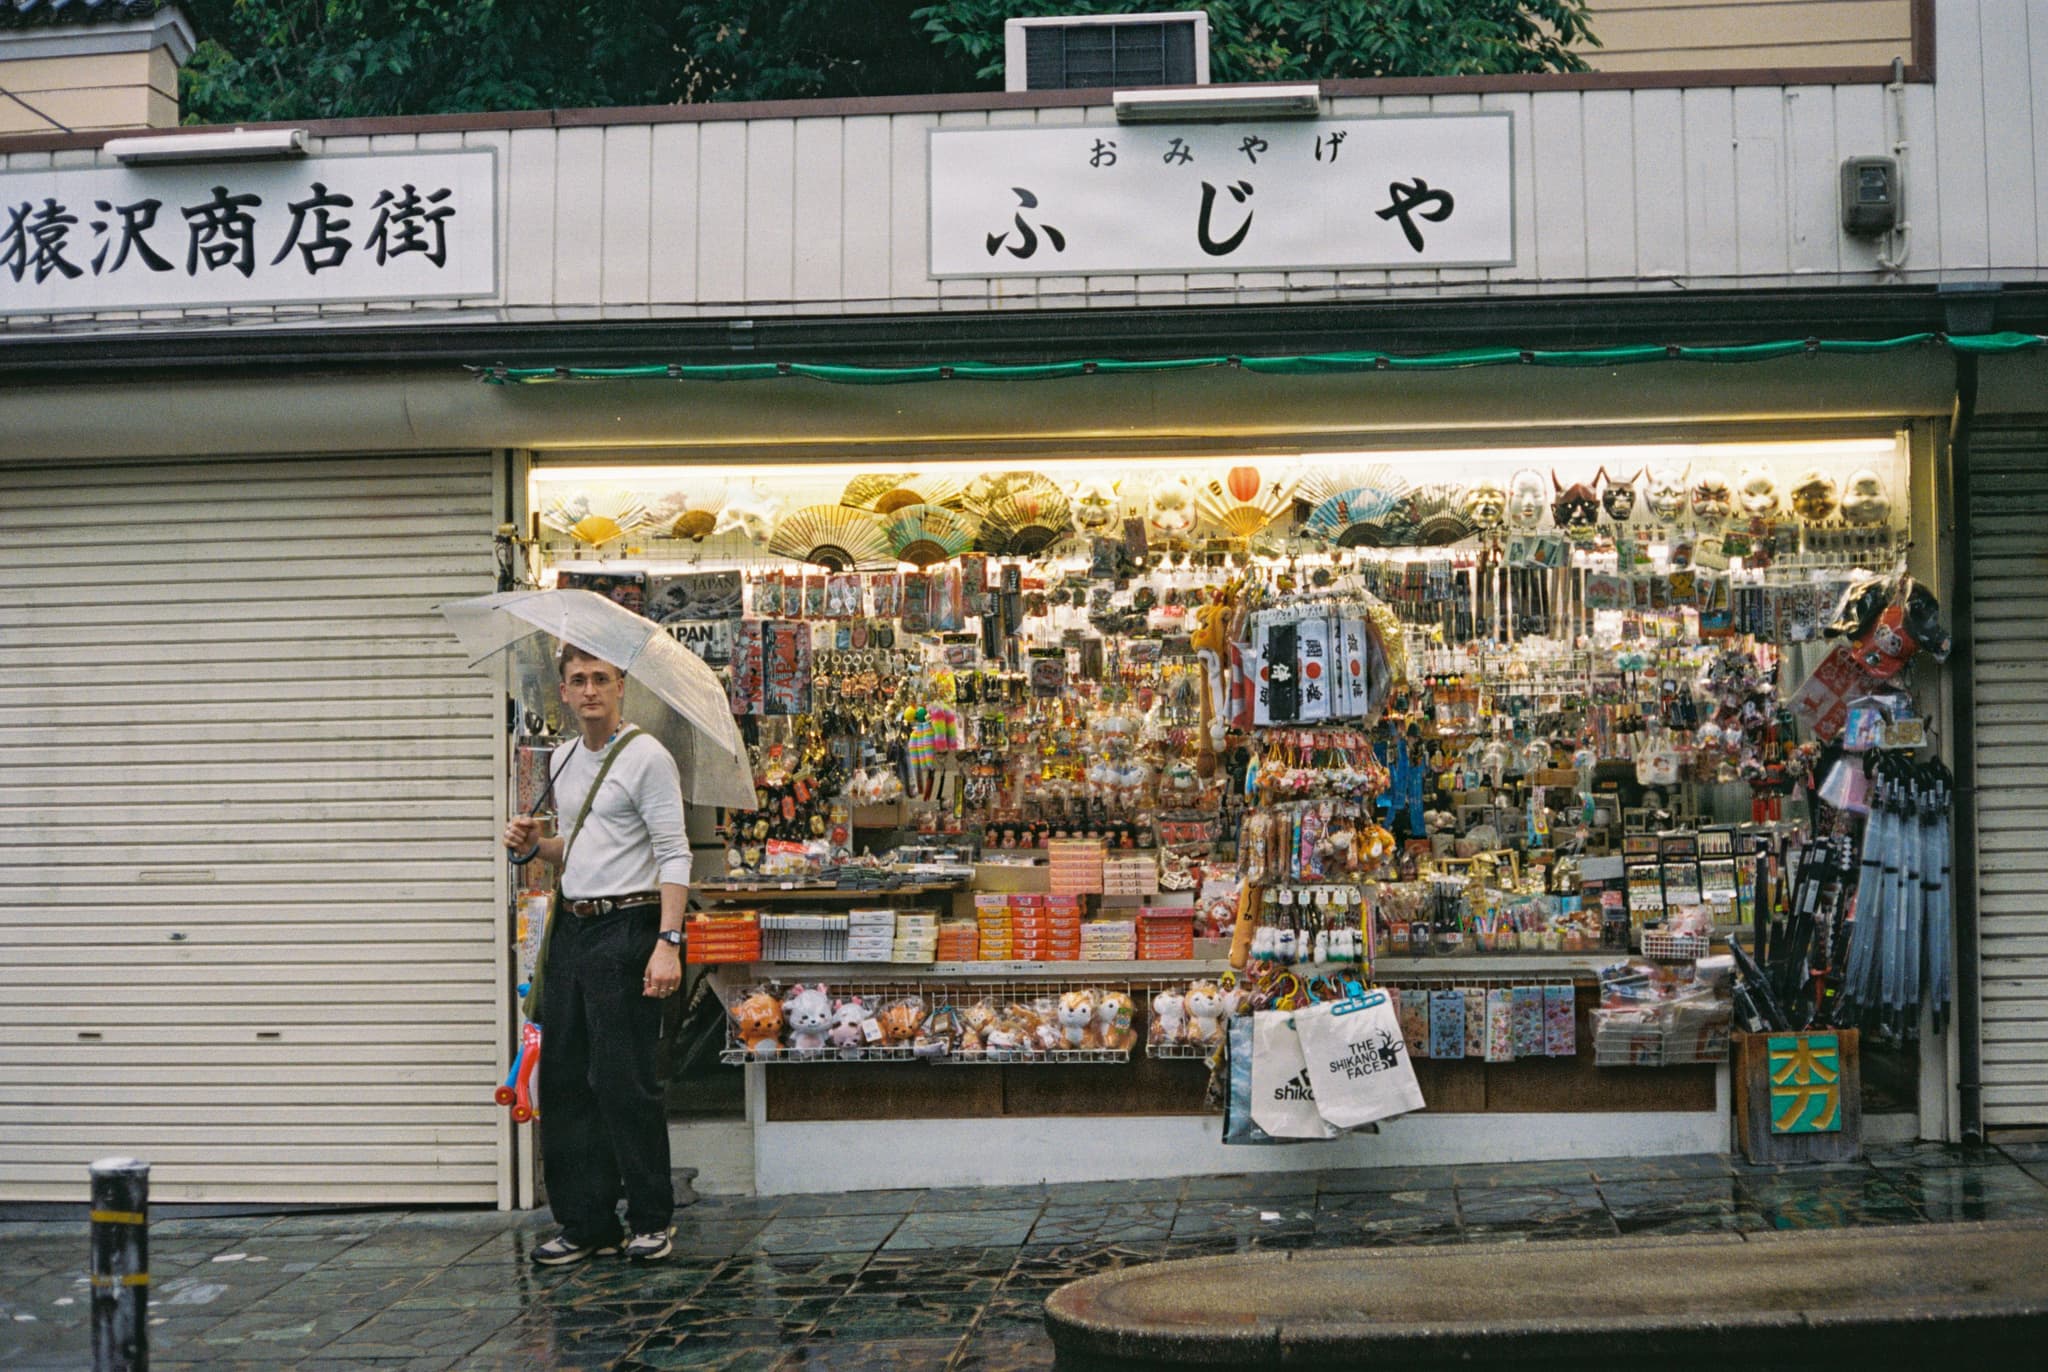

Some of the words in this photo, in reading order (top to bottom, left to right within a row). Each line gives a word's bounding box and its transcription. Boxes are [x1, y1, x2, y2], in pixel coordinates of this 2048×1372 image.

[1088, 130, 1348, 168] おみやげ
[0, 181, 456, 285] 猿沢商店街
[985, 177, 1456, 260] ふじや
[692, 576, 735, 592] JAPAN
[665, 625, 713, 642] APAN
[775, 630, 796, 704] JAPAN
[1329, 1050, 1378, 1073] SHIKANO
[1348, 1038, 1375, 1055] THE
[1346, 1061, 1381, 1080] FACE
[1770, 1038, 1838, 1131] 木刀
